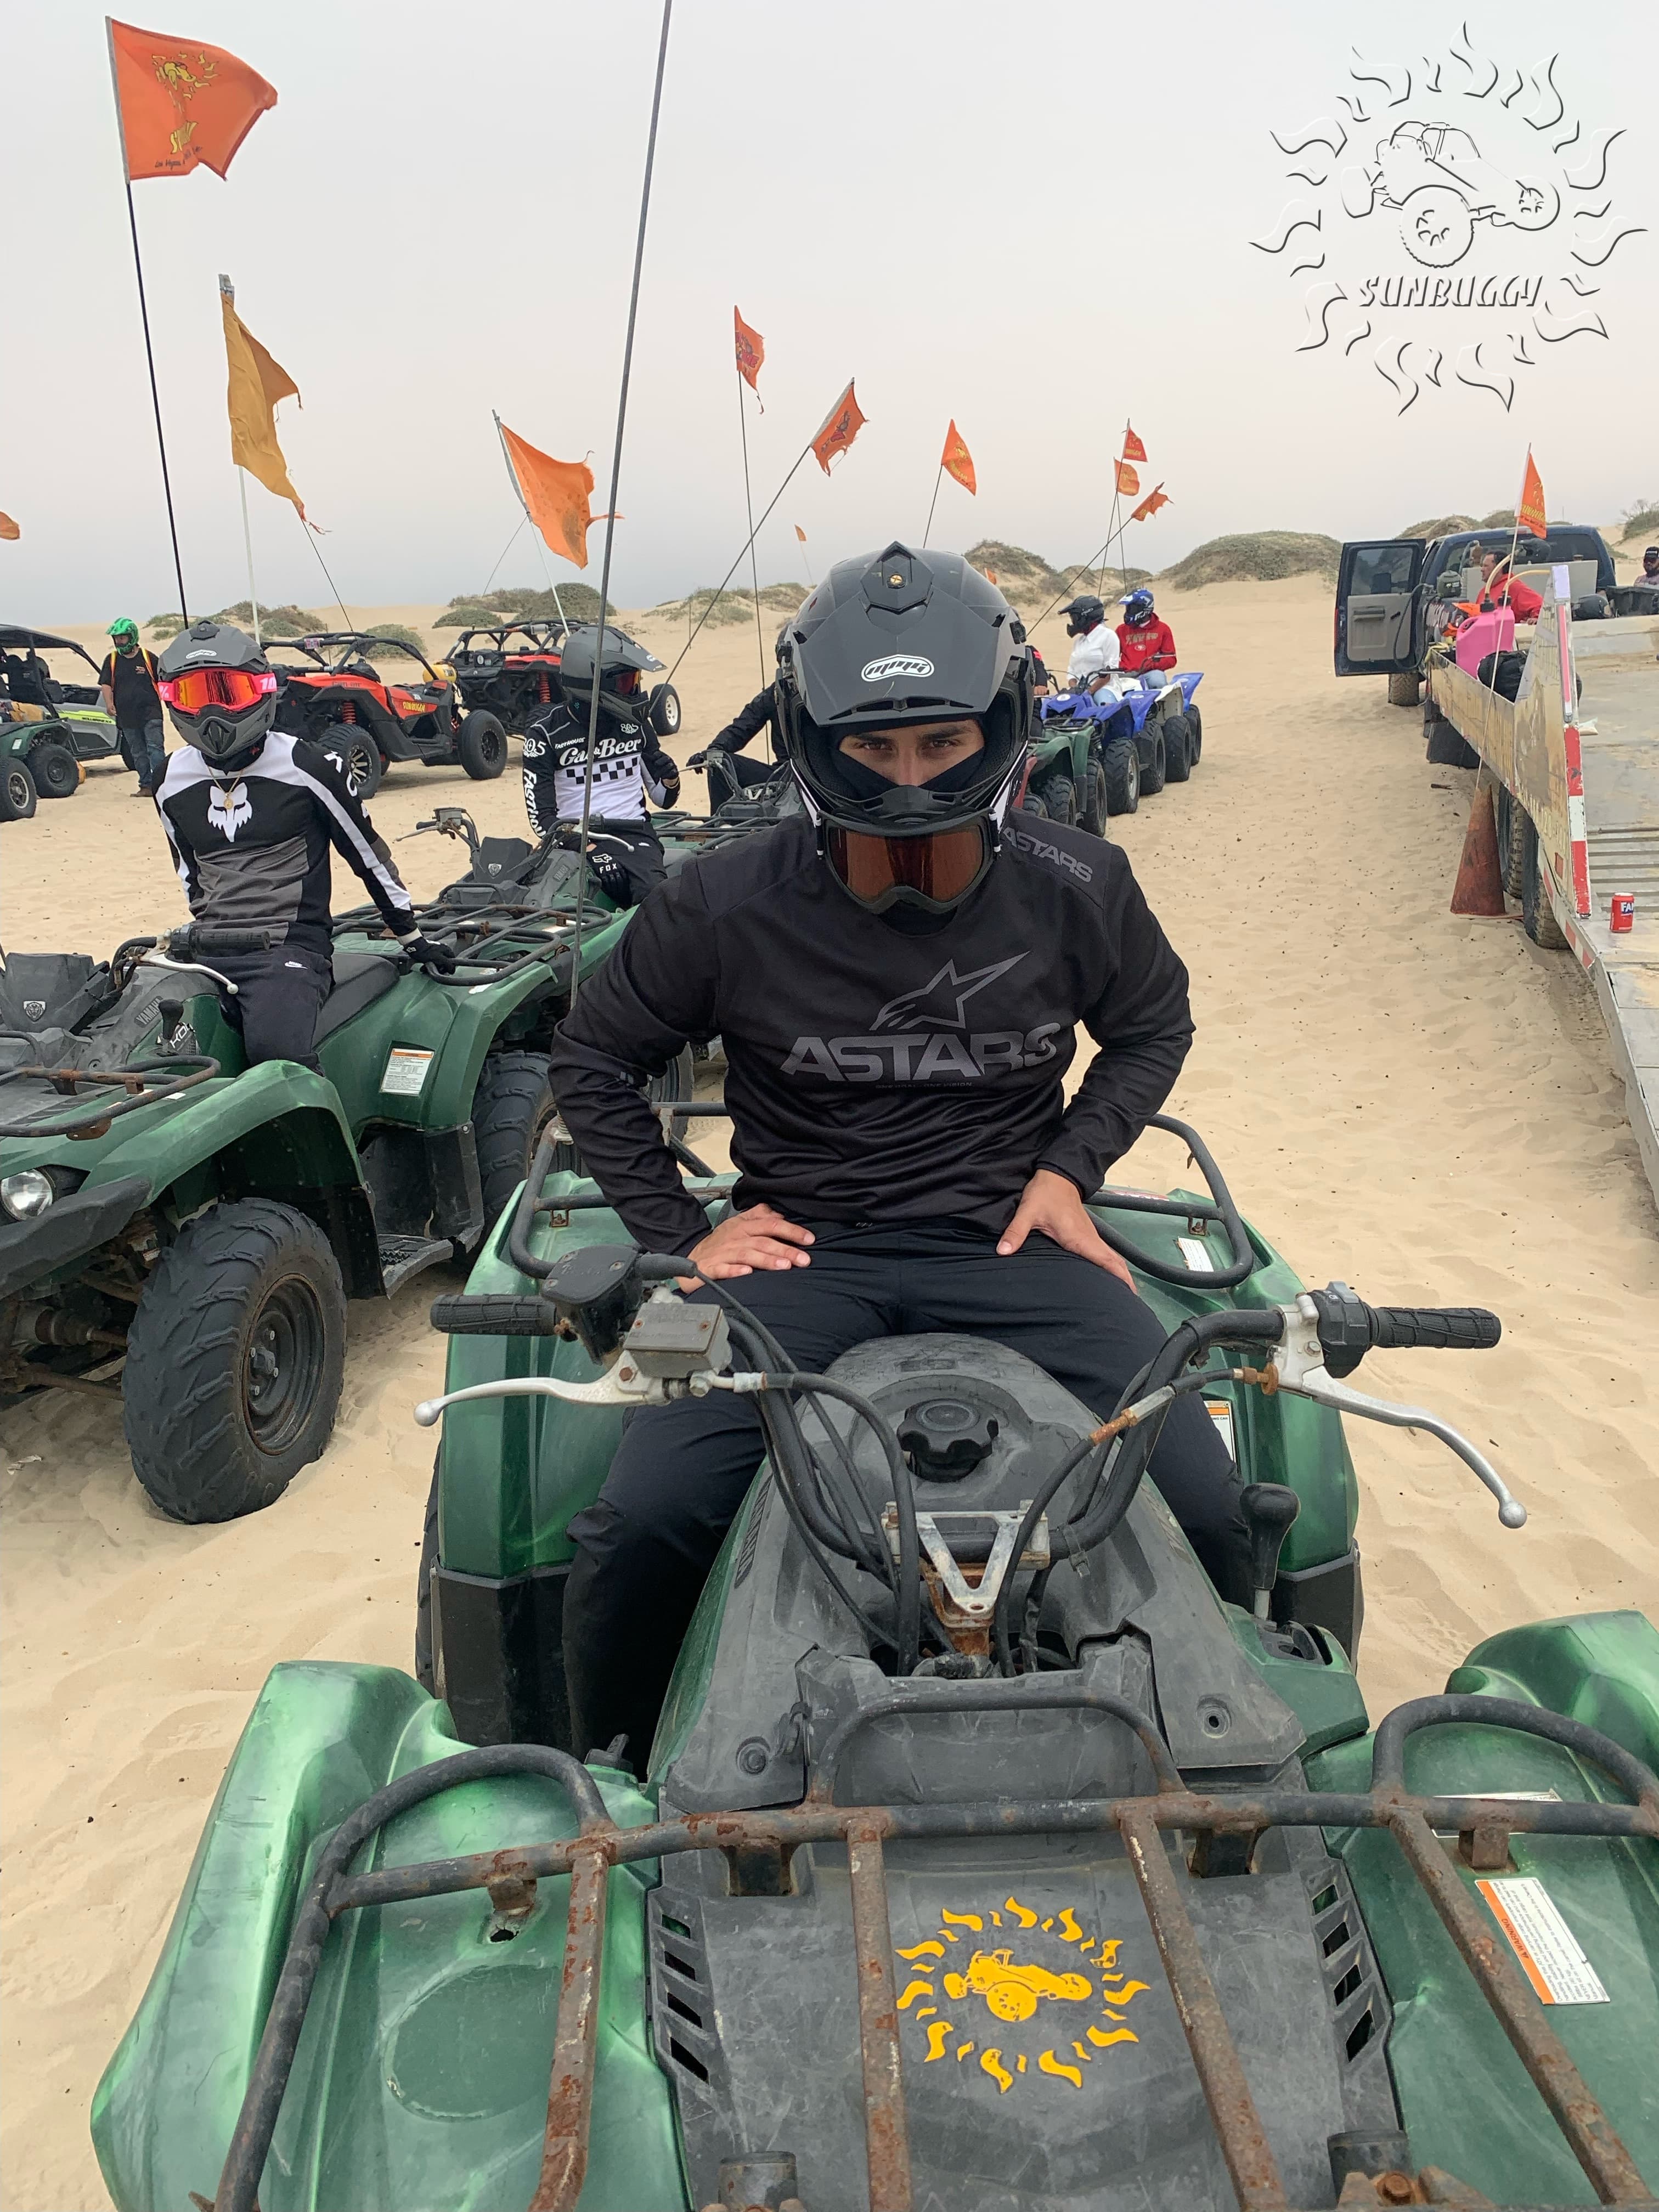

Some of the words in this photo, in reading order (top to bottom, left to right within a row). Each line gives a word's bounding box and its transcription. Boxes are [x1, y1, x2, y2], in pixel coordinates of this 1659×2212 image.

[554, 737, 586, 749] FASTHOUSE
[559, 747, 590, 766] Ga
[598, 737, 641, 759] Beer
[599, 863, 618, 874] FOX
[1002, 826, 1093, 883] ASTARS
[780, 1022, 1061, 1082] ASTARS
[1502, 1918, 1524, 1951] WARNING
